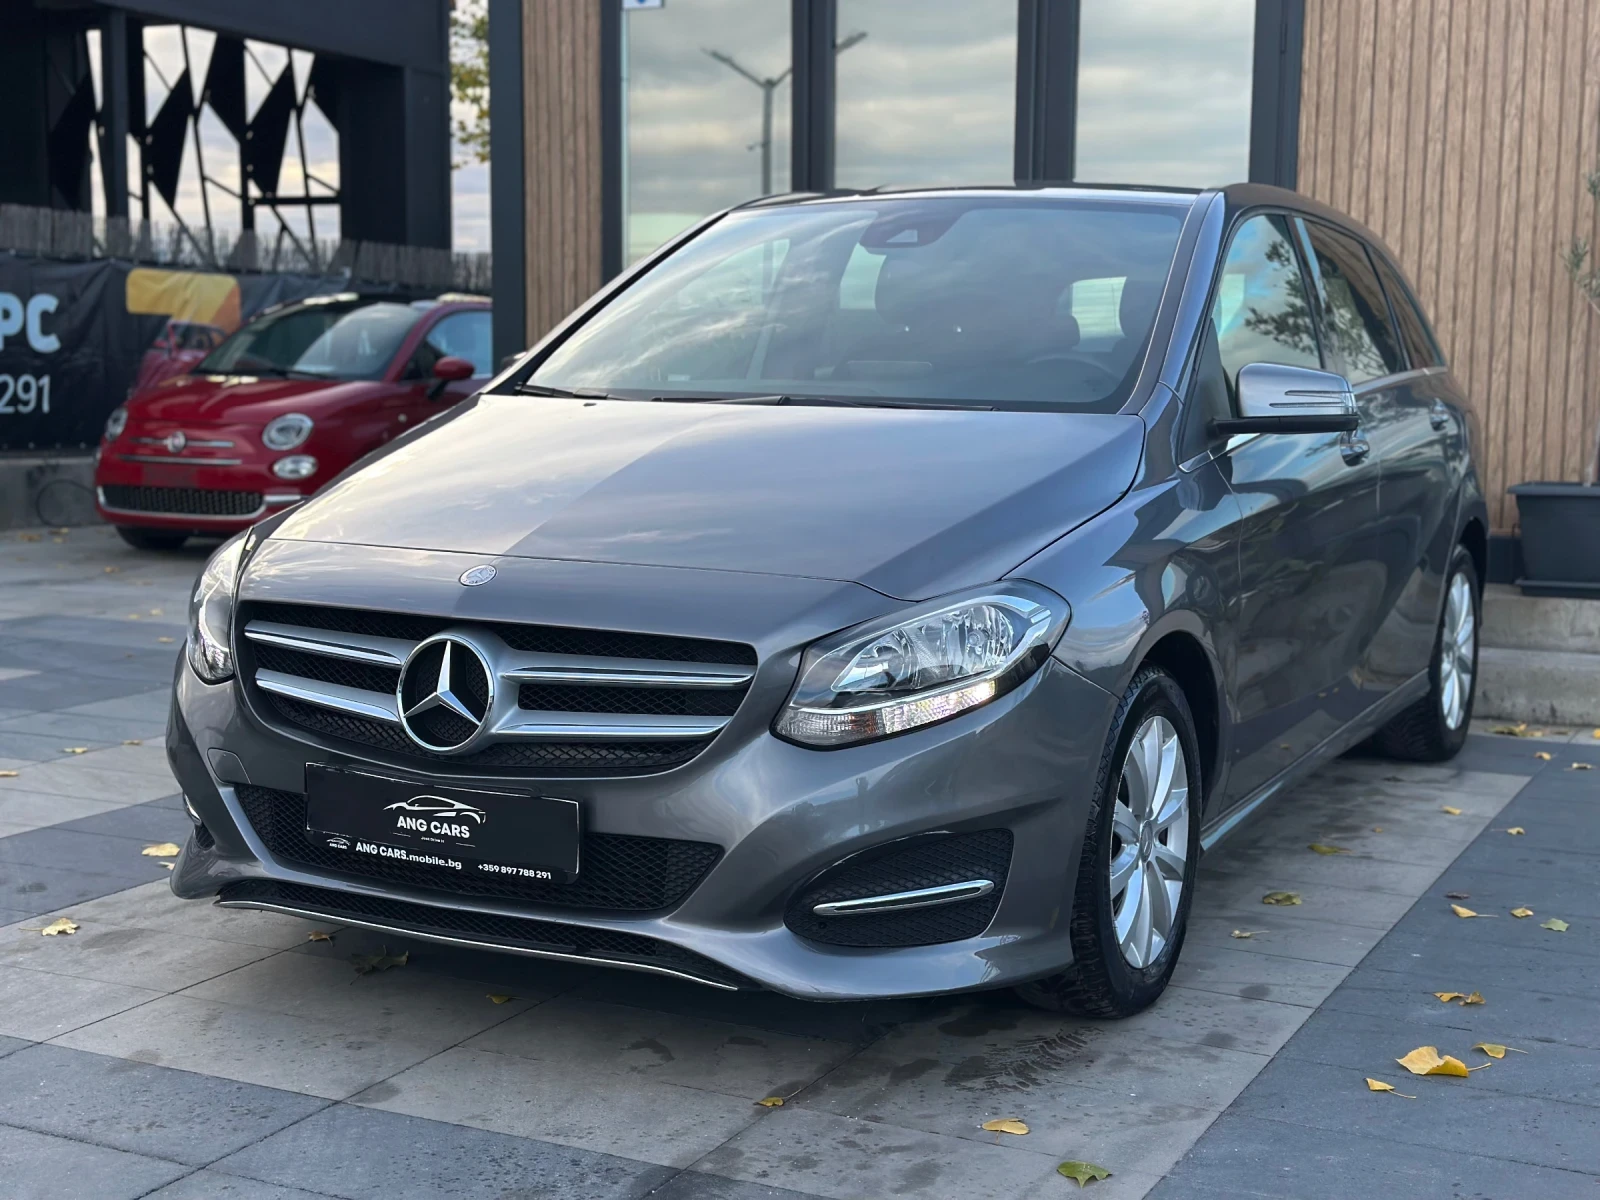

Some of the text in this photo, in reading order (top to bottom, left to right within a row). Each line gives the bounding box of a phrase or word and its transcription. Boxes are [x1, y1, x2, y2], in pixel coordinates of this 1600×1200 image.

[0, 373, 51, 414] 291
[396, 815, 470, 838] ANG CARS
[355, 841, 462, 870] ANG CARS.mobile.bg
[477, 863, 551, 880] +359 897 788 291
